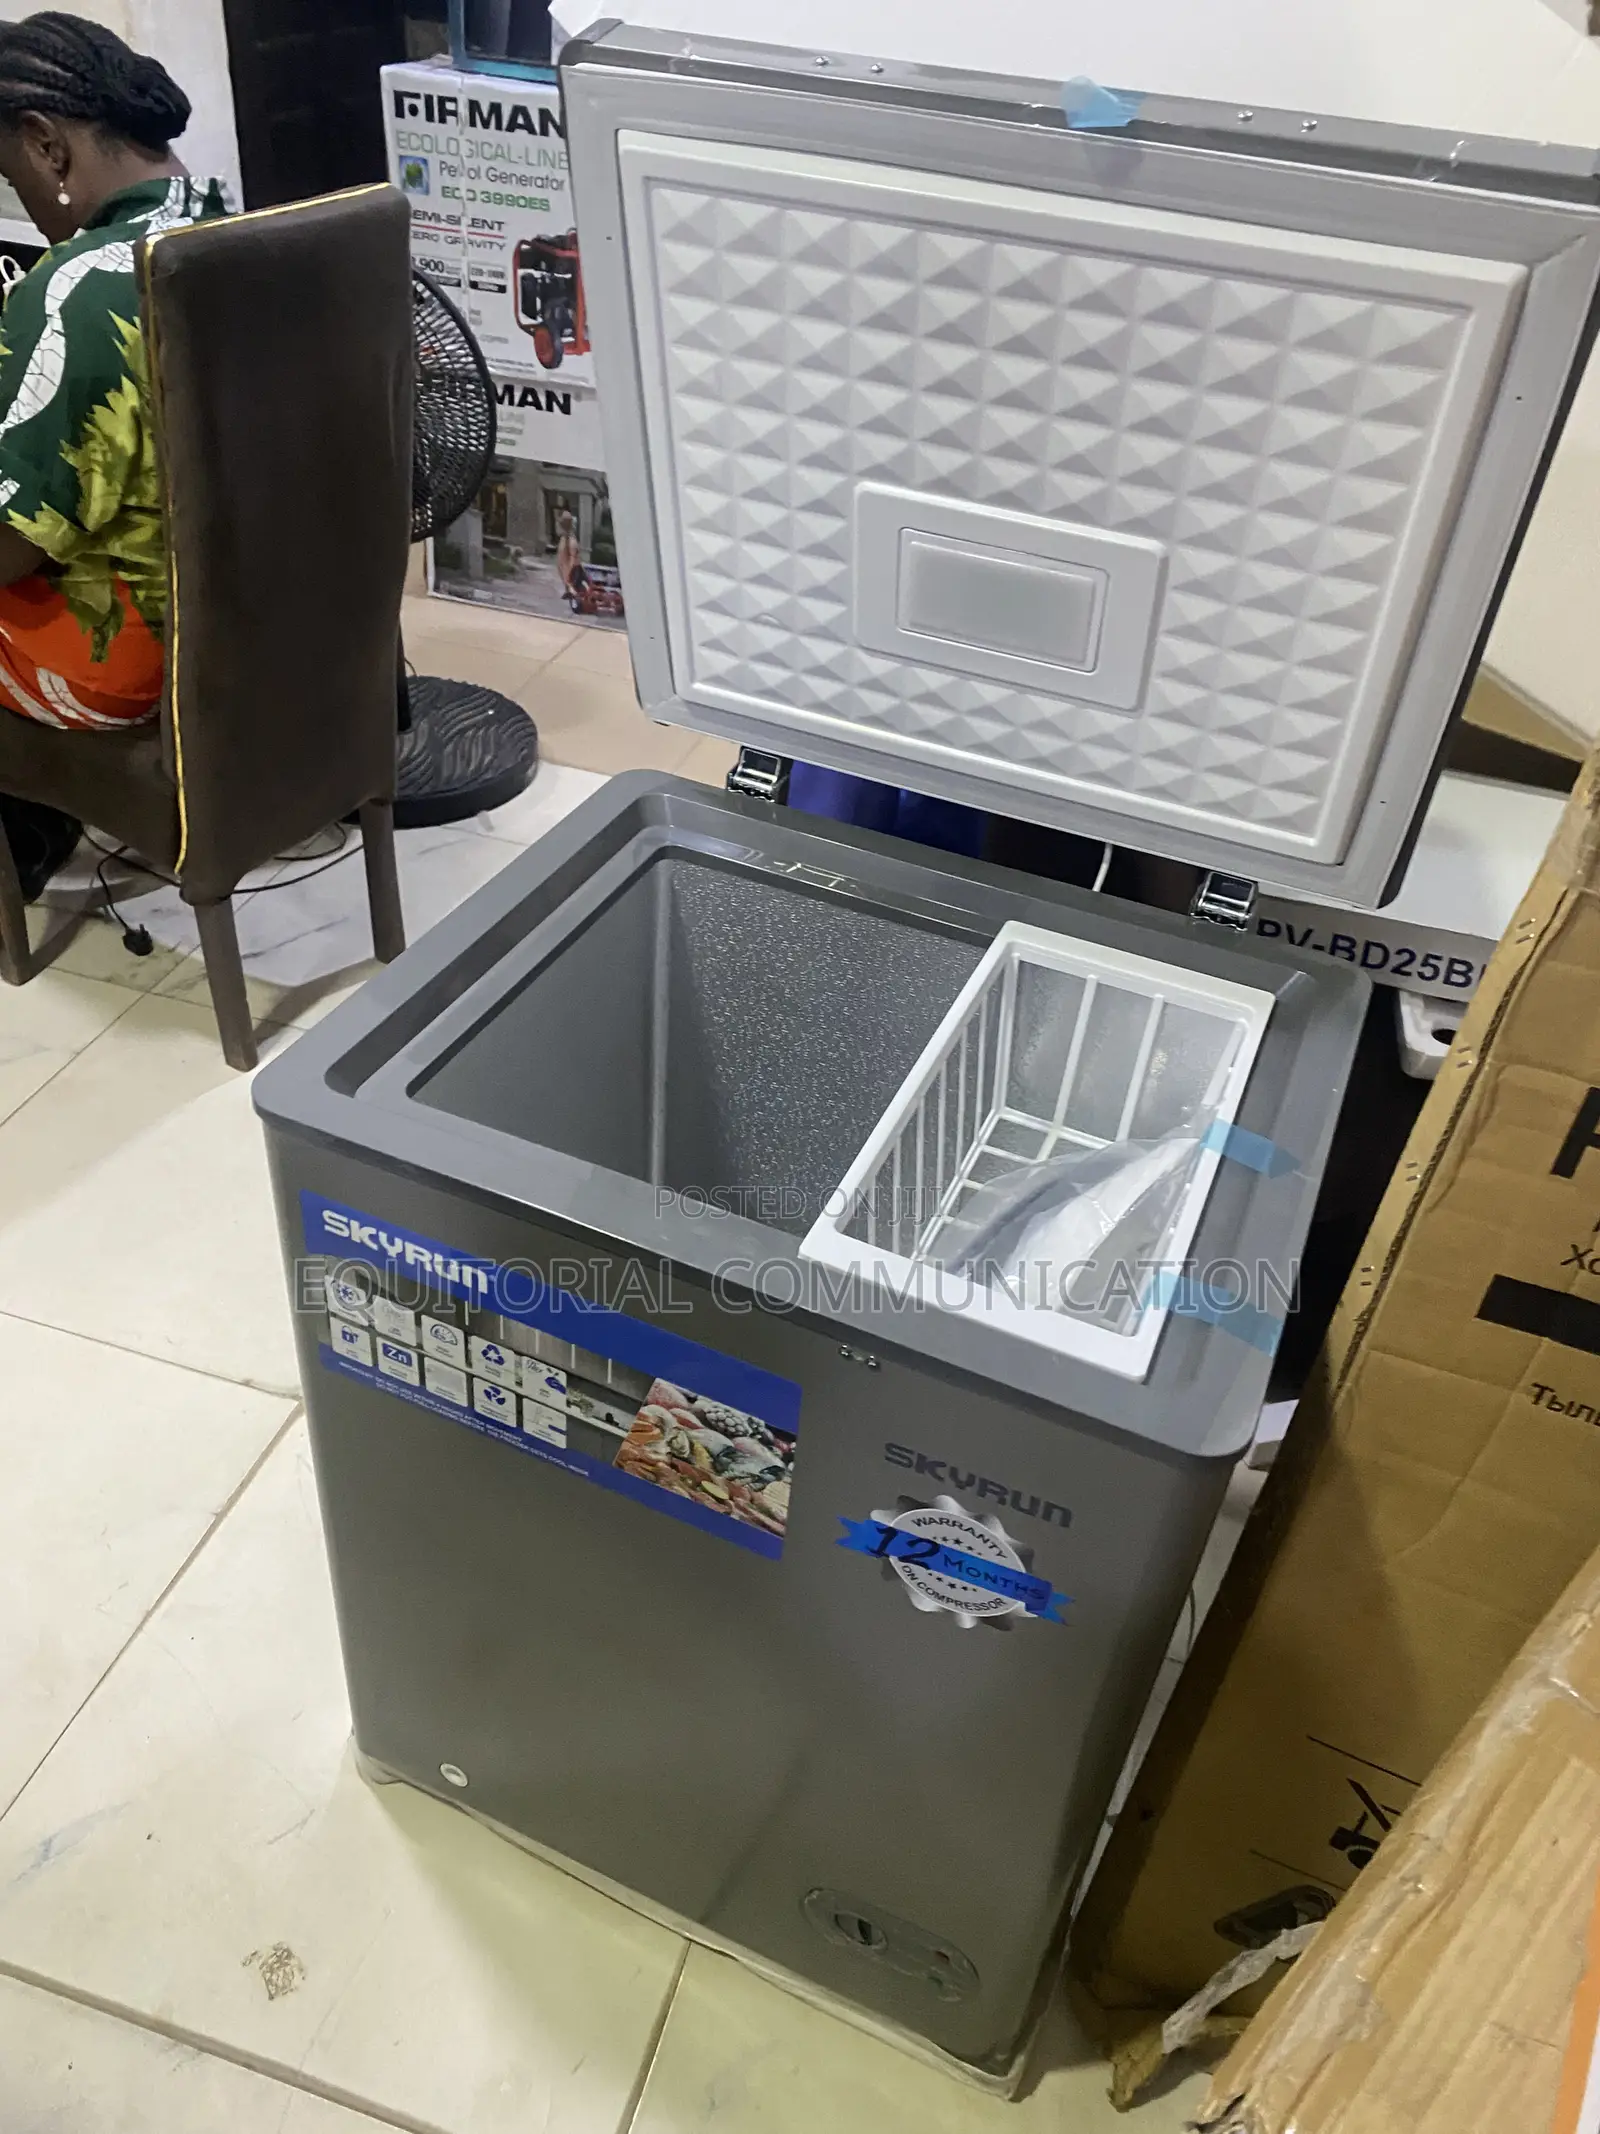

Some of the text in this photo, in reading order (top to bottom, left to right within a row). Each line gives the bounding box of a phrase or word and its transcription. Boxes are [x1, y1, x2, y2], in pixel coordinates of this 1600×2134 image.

[439, 160, 565, 191] Peol Generator
[412, 231, 440, 242] ERO
[413, 209, 505, 231] EMI-SIENT
[866, 1525, 942, 1571] 12
[911, 1516, 1009, 1559] WARRANTY
[902, 1564, 1007, 1612] ON COMPRESSOR
[943, 1553, 1046, 1601] MONTHS
